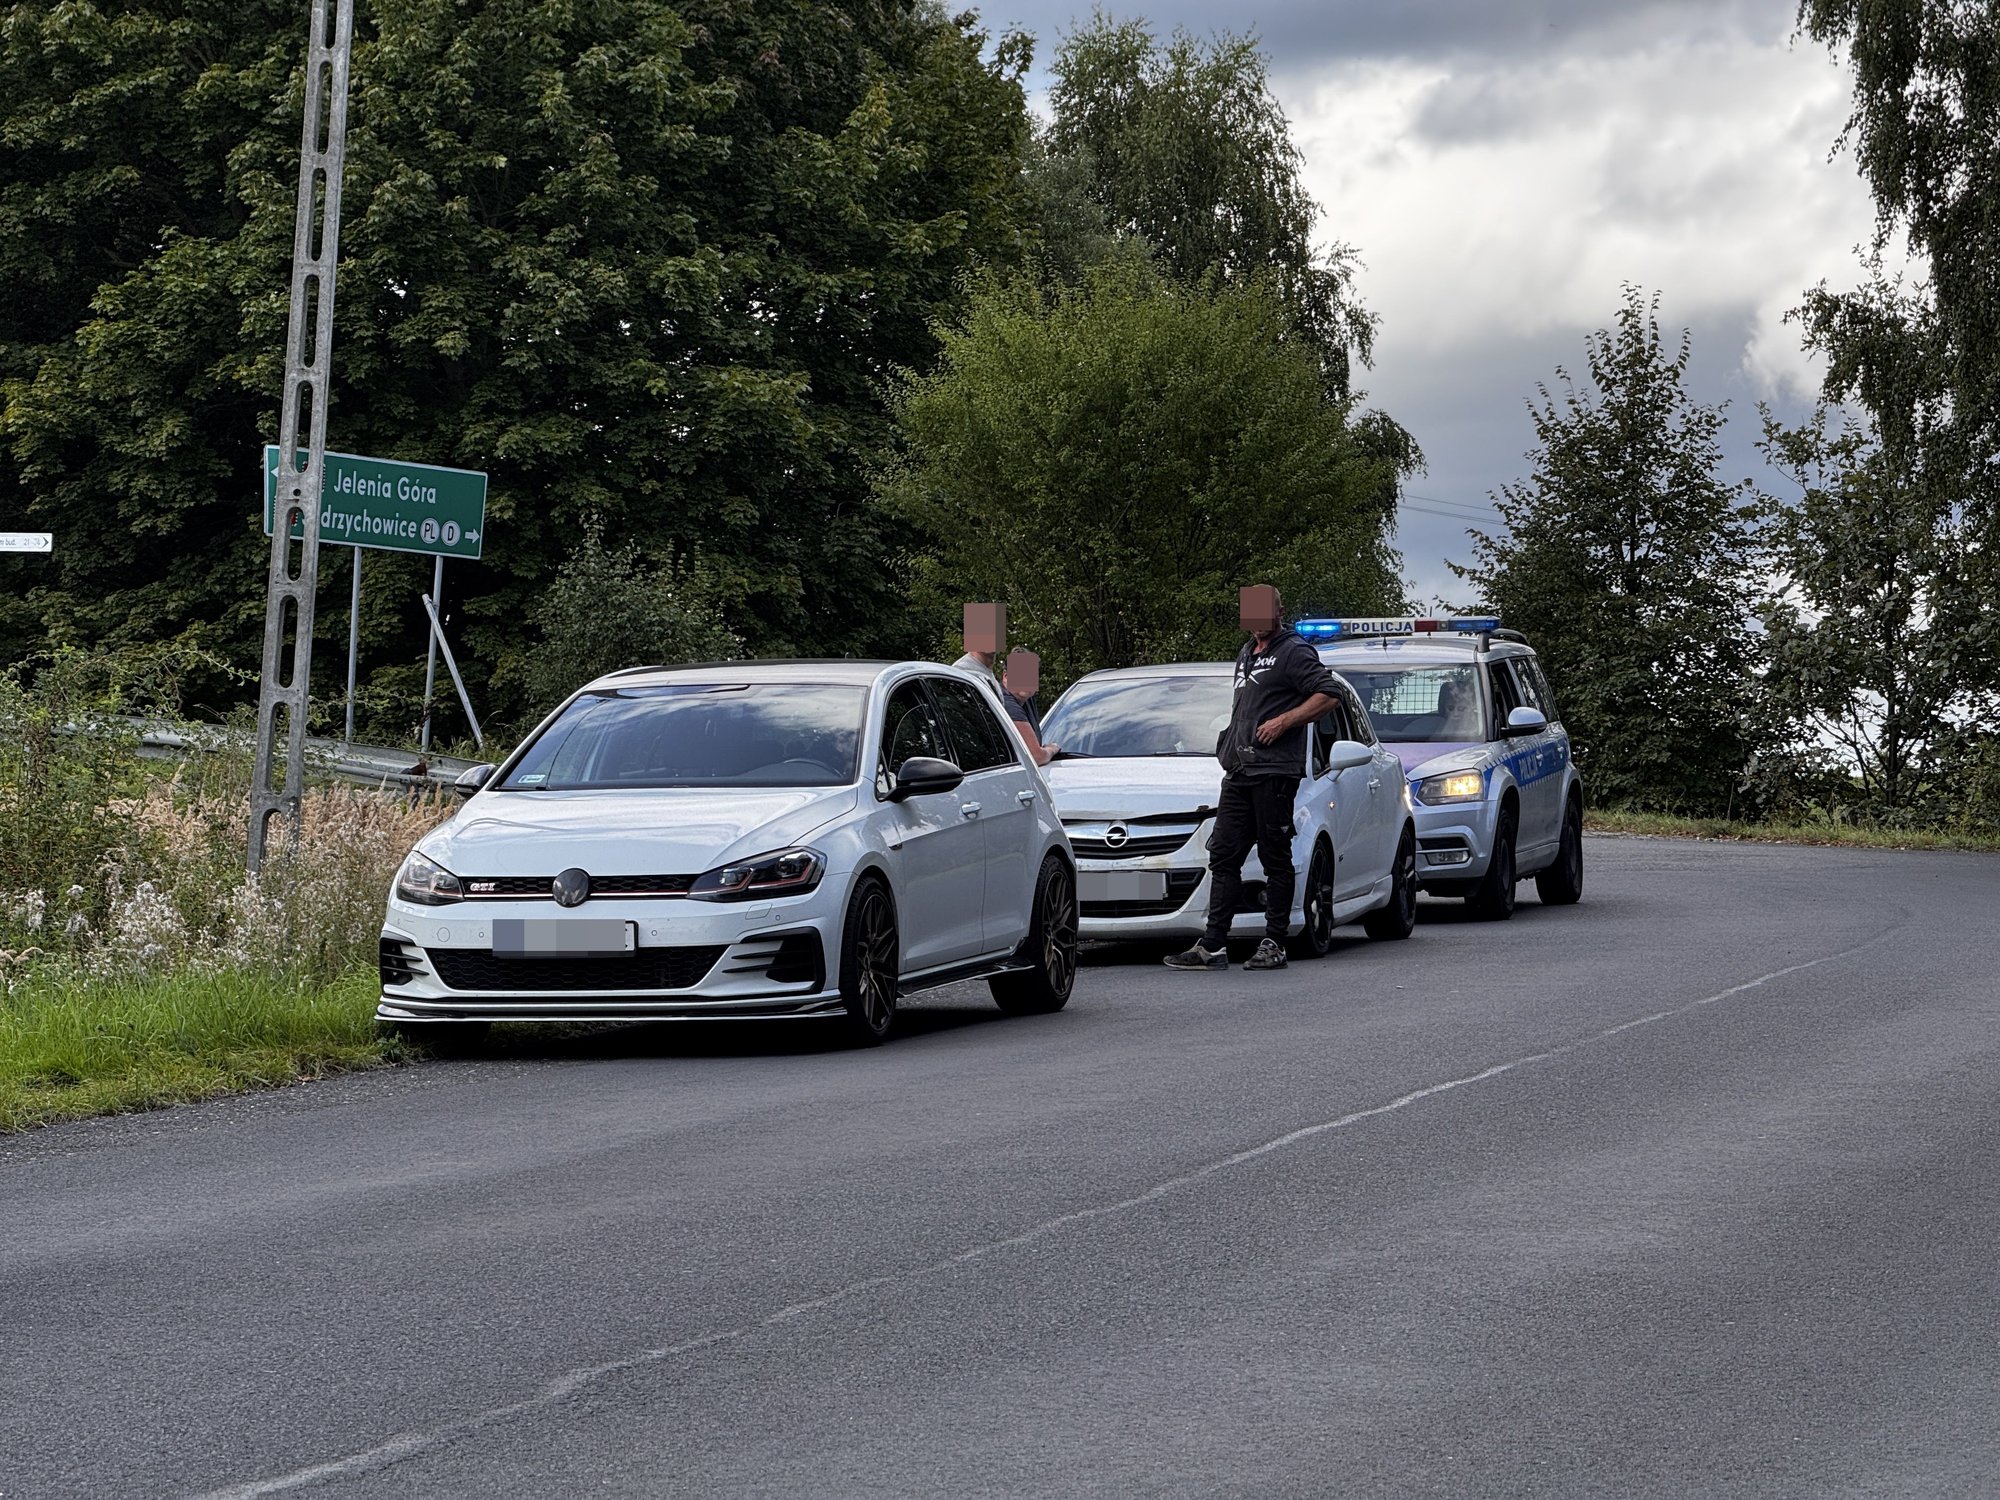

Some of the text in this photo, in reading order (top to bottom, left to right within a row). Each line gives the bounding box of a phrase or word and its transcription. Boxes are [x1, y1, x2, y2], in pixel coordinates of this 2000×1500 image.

[333, 468, 437, 504] Jelenia Góra
[320, 503, 417, 538] drzychowice
[1351, 621, 1414, 633] POLICJA
[469, 882, 496, 892] GTI
